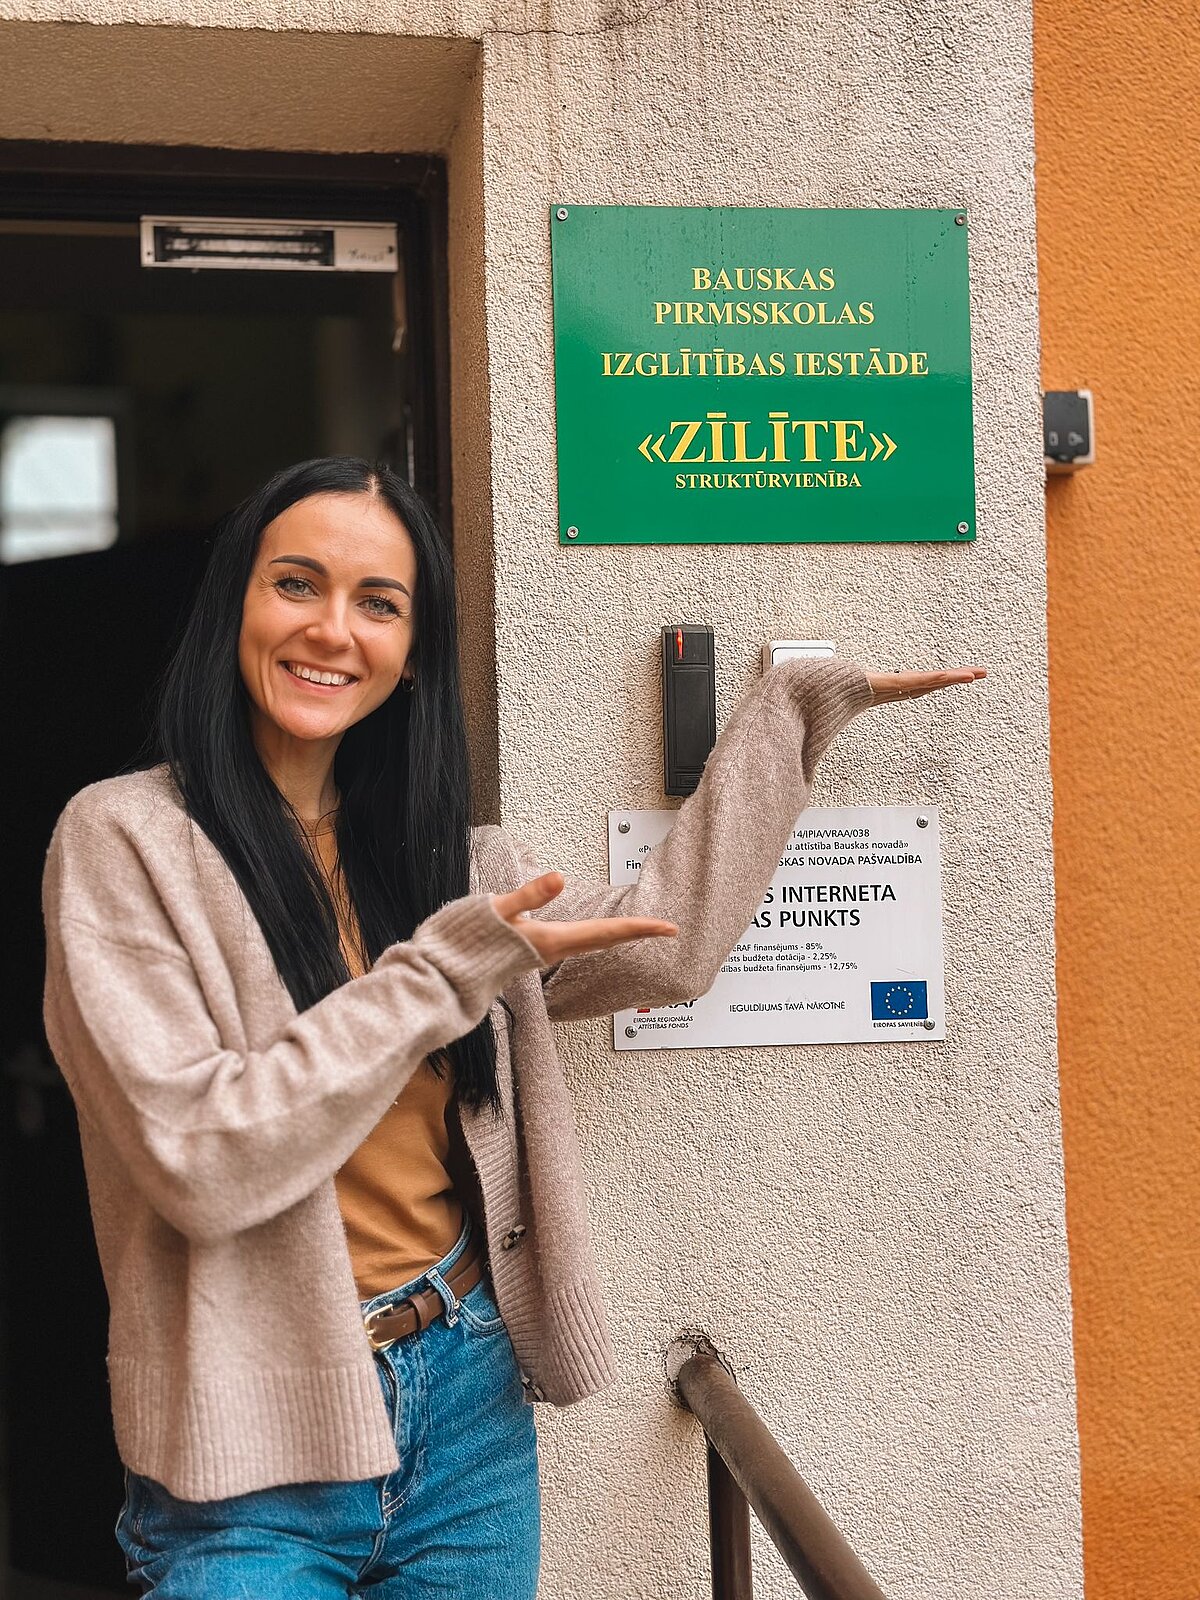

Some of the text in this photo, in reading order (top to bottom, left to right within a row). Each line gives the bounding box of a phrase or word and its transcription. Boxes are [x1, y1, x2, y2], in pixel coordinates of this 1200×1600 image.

[692, 267, 835, 290] BAUSKAS
[654, 301, 875, 325] PIRMSSKOLAS
[600, 347, 929, 376] IZGLĪTĪBAS IESTĀDE
[637, 411, 898, 463] «ZĪLĪTE»
[675, 471, 862, 489] STRUKTŪRVIENĪBA
[795, 841, 831, 850] attīstība
[834, 841, 869, 850] Bauskas
[871, 840, 909, 849] novadā»
[808, 856, 855, 866] NOVADA
[858, 853, 922, 865] PAŠVALDĪBA
[782, 884, 896, 903] INTERNETA
[780, 909, 860, 927] PUNKTS
[754, 943, 798, 952] finansējums
[742, 953, 773, 961] budžeta
[776, 953, 806, 962] dotācija
[813, 952, 838, 961] 2,25%
[743, 964, 774, 972] budžeta
[776, 963, 822, 973] finansējums
[829, 962, 858, 971] 12,75%
